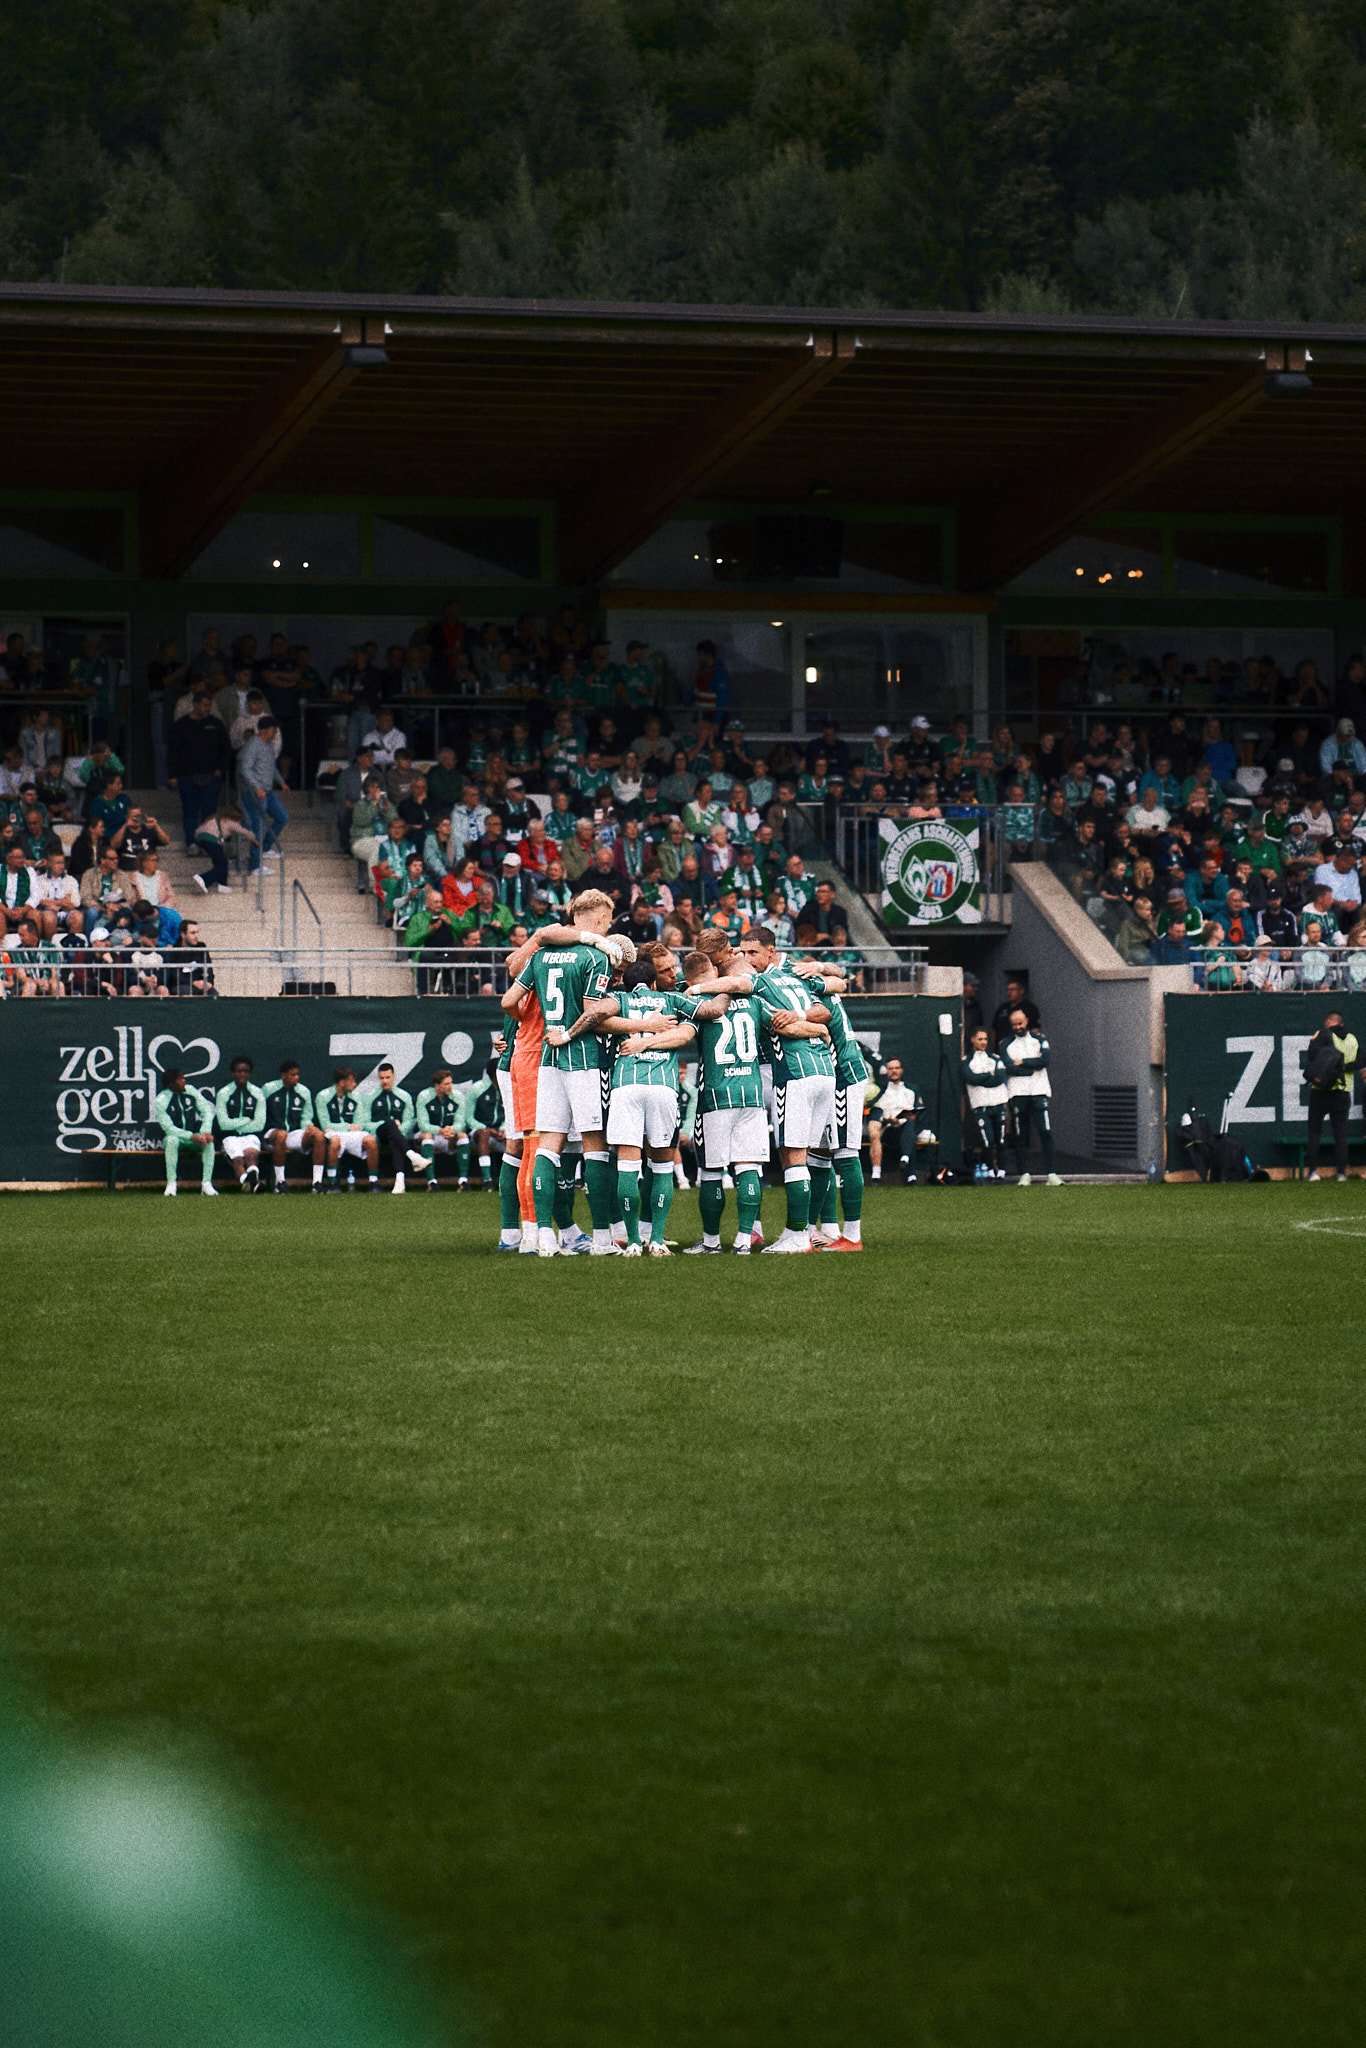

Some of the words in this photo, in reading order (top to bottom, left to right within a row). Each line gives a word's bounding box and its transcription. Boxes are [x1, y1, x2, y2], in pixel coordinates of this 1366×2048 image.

[542, 952, 578, 963] WERDER
[545, 967, 565, 1021] 5
[628, 996, 667, 1008] WERDER
[58, 1025, 148, 1082] zell
[712, 1012, 758, 1065] 20
[724, 1067, 752, 1077] SCHMID
[55, 1068, 217, 1154] gerls
